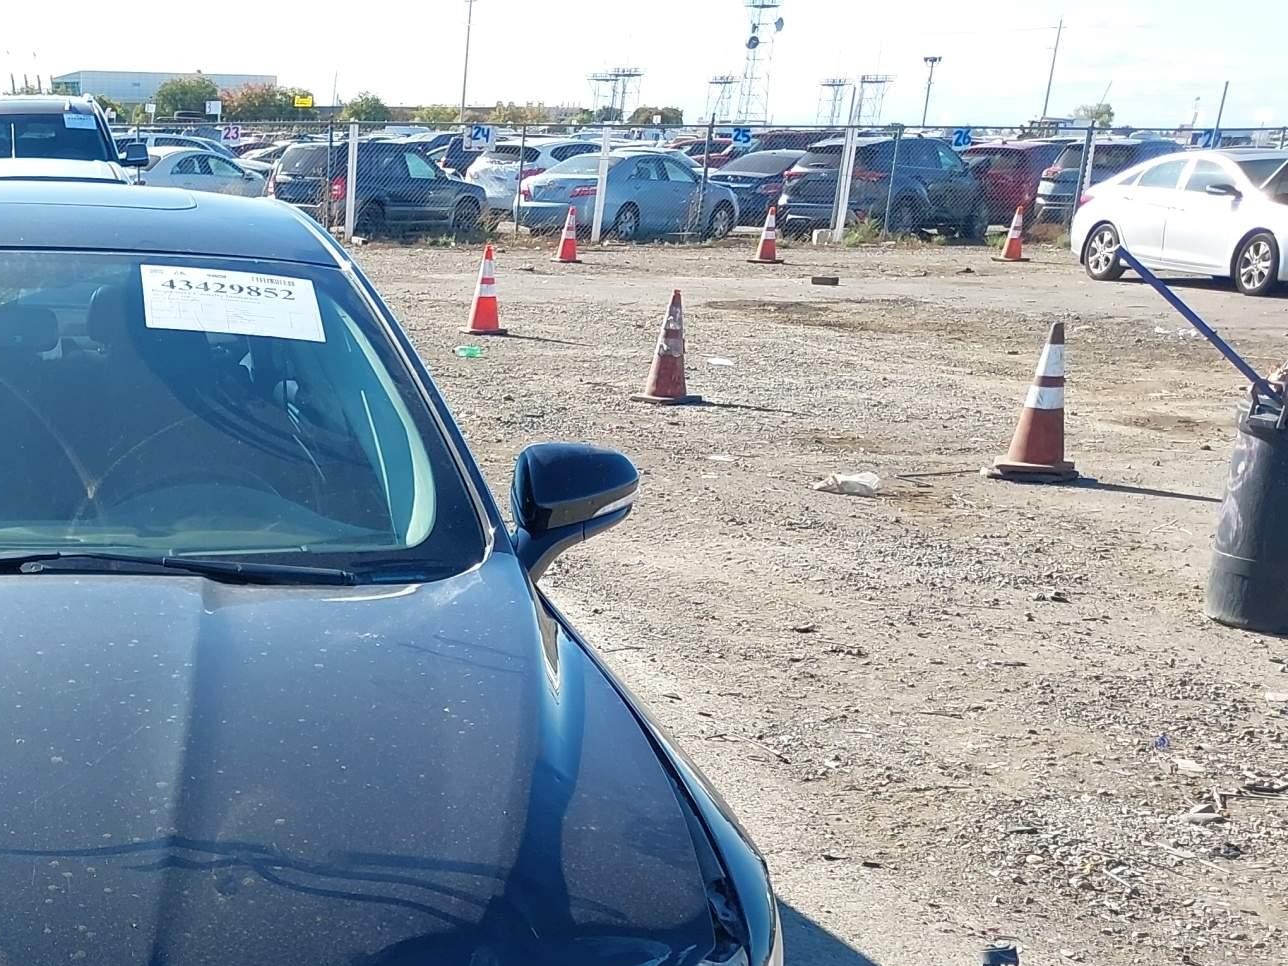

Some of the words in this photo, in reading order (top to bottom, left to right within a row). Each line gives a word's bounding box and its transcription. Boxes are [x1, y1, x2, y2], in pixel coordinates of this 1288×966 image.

[222, 127, 240, 140] 23
[472, 126, 490, 143] 24
[733, 128, 751, 143] 25
[953, 128, 972, 146] 26
[160, 279, 296, 301] 43429852
